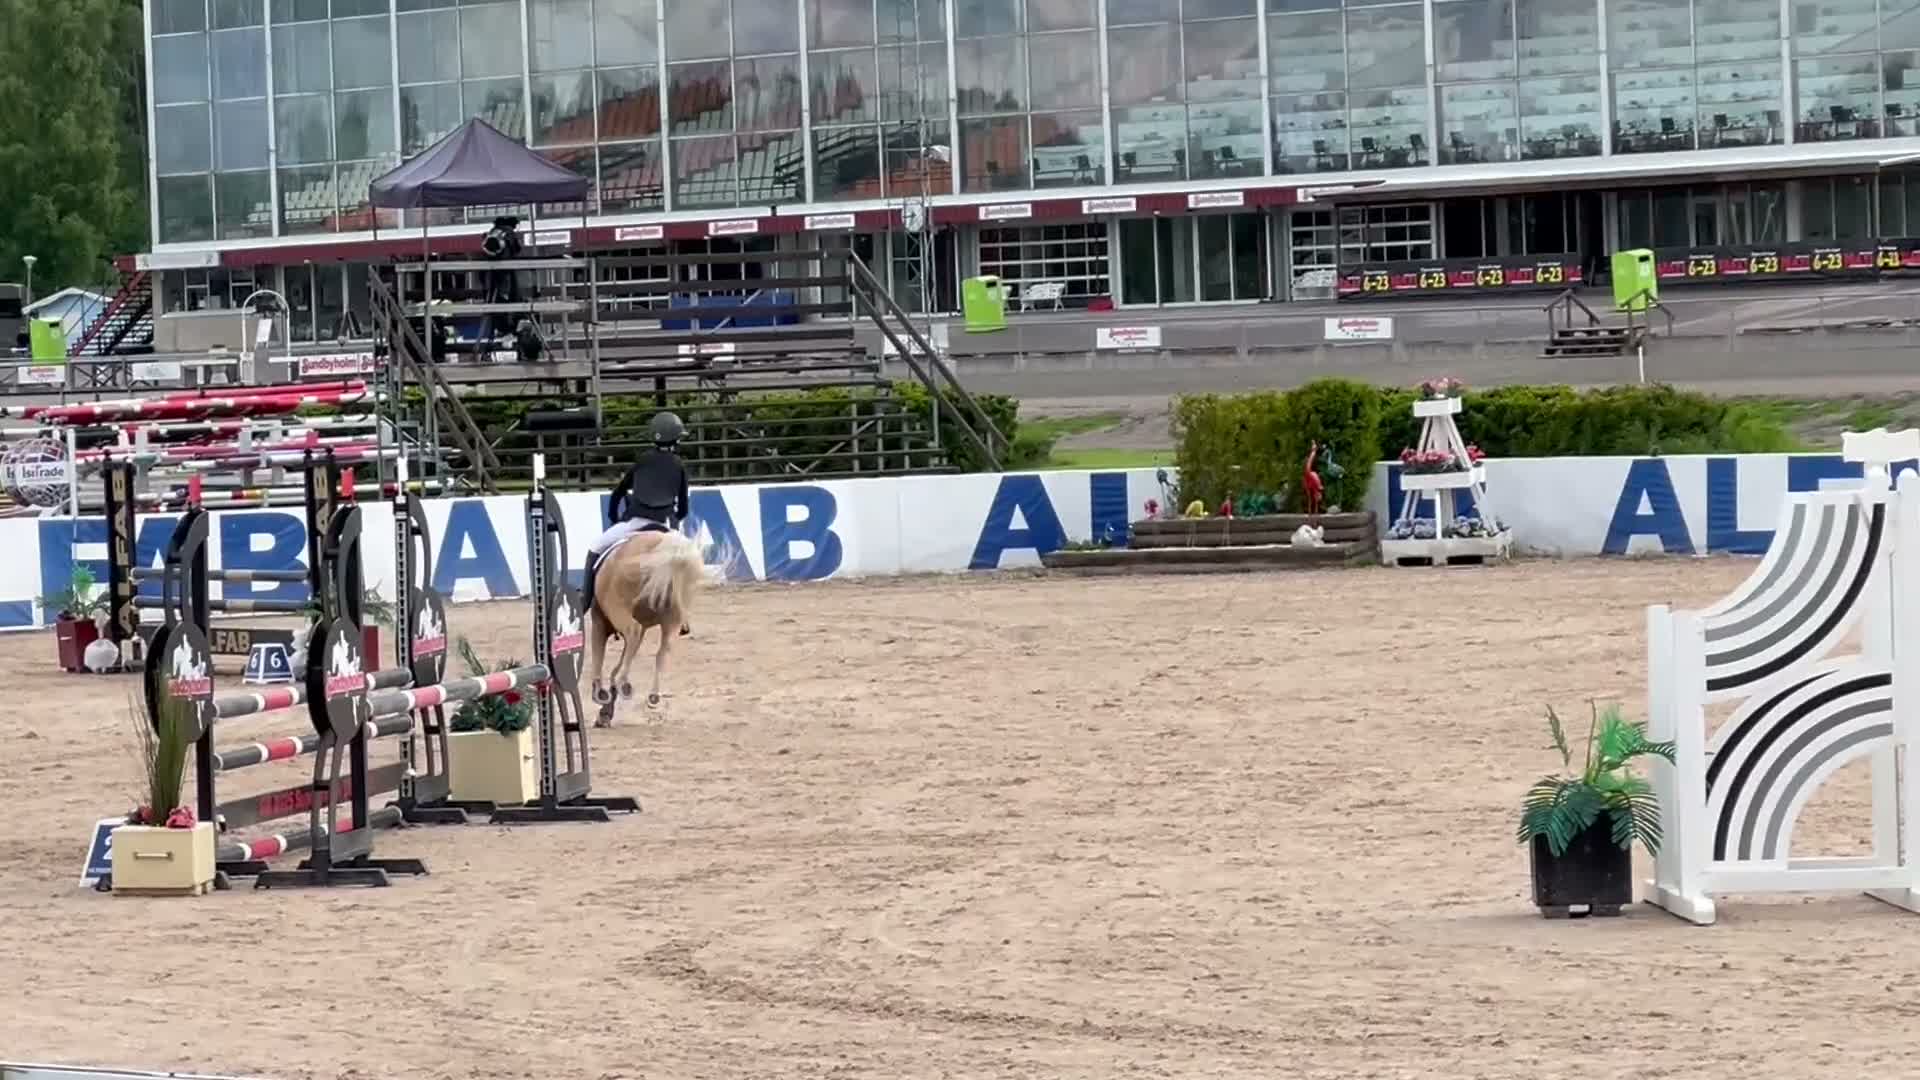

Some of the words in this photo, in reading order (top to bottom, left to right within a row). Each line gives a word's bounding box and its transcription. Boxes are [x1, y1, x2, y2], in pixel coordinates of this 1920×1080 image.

[1688, 260, 1716, 276] 6-23
[1750, 257, 1778, 273] 6-23
[1420, 272, 1446, 288] 6-23
[1477, 270, 1503, 285] 6-23
[1536, 267, 1562, 282] 6-23
[1363, 275, 1389, 291] 6-23
[250, 652, 259, 669] 6
[270, 652, 282, 668] 6
